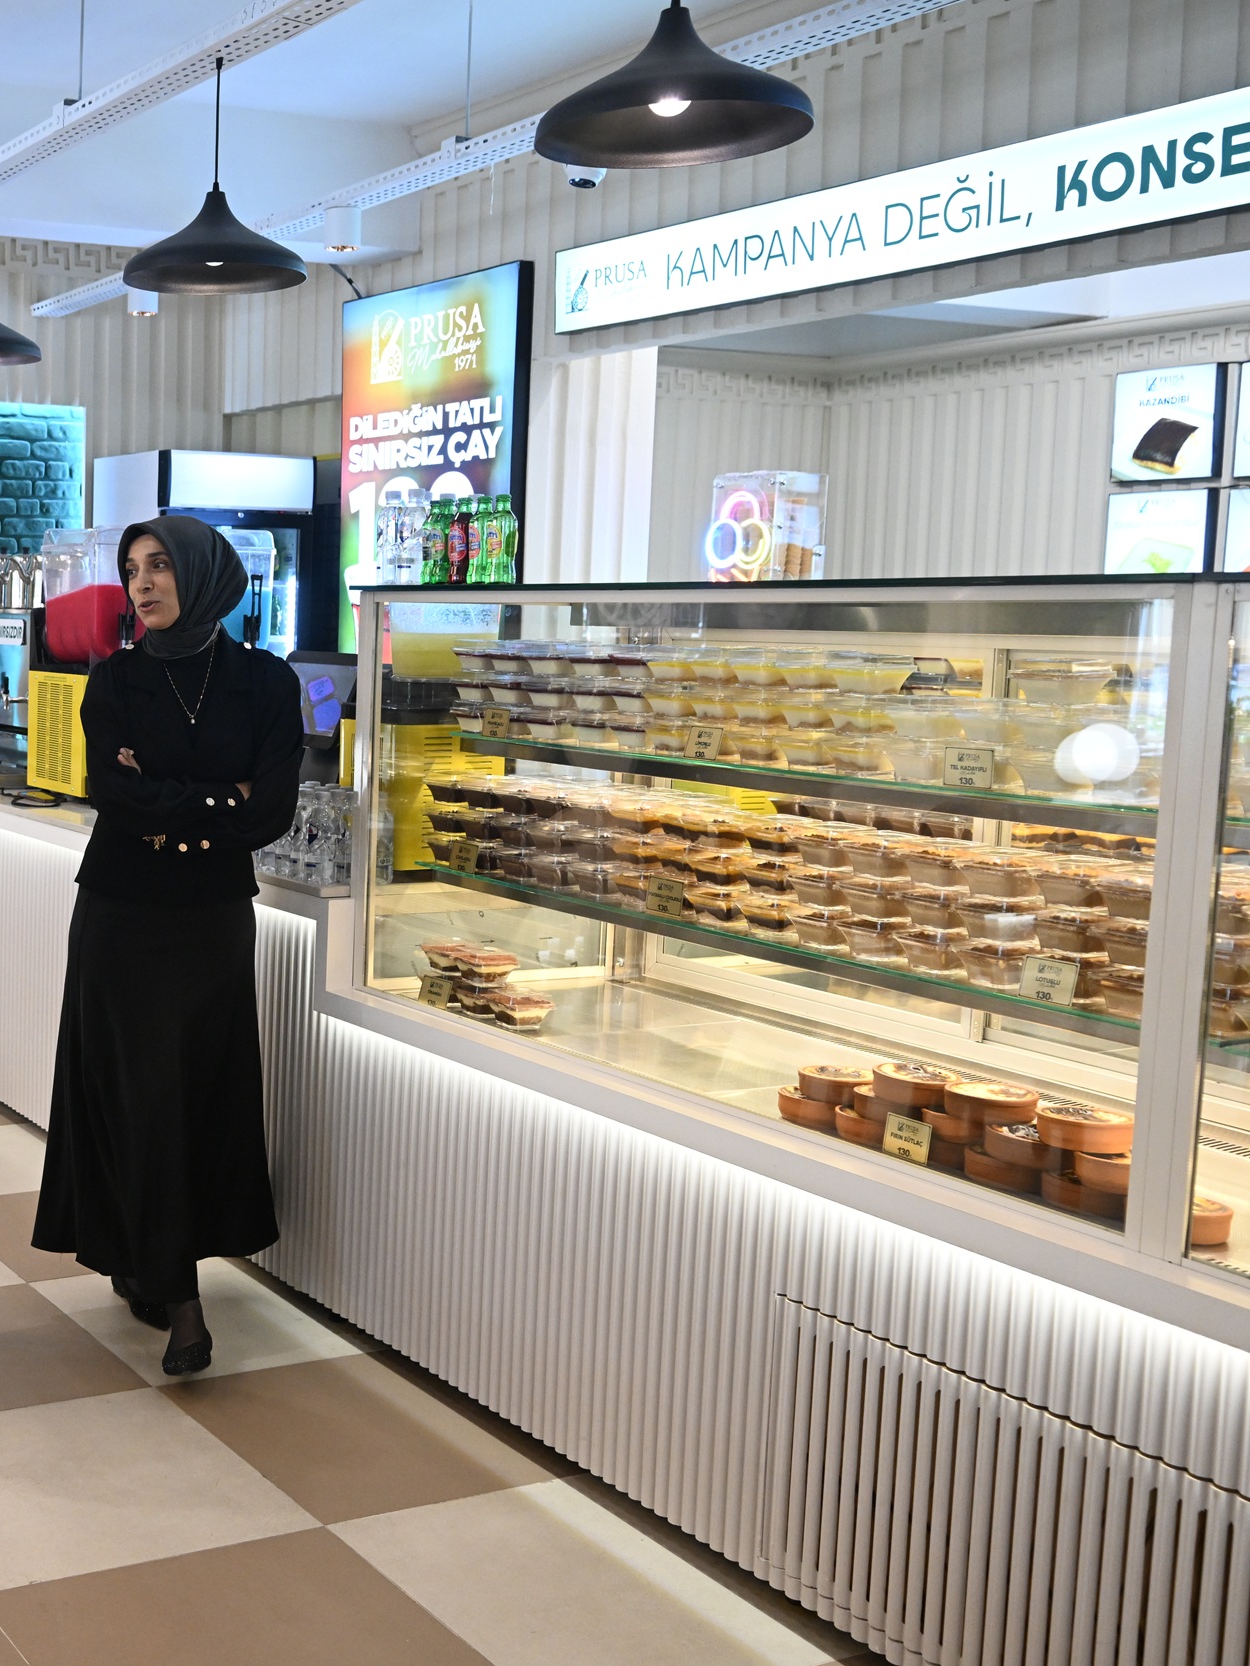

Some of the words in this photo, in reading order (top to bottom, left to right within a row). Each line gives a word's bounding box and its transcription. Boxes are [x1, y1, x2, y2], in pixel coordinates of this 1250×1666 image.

[666, 212, 867, 290] KAMPANYA
[883, 170, 1033, 248] DEĞİL,
[1054, 121, 1250, 213] KONSE
[594, 260, 647, 287] PRUSA
[408, 302, 485, 347] PRUSA
[454, 353, 477, 372] 1971
[1139, 392, 1190, 407] KAZANDİBİ
[349, 403, 444, 441] DİLEDİĞİN
[445, 395, 503, 428] TATLI
[348, 434, 445, 473] SINIRSIZ
[447, 426, 504, 468] ÇAY
[959, 777, 974, 786] 130
[1035, 976, 1061, 986] LOTUSLU
[1036, 990, 1052, 1001] 130
[890, 1132, 904, 1141] FIRIN
[897, 1146, 911, 1157] 130
